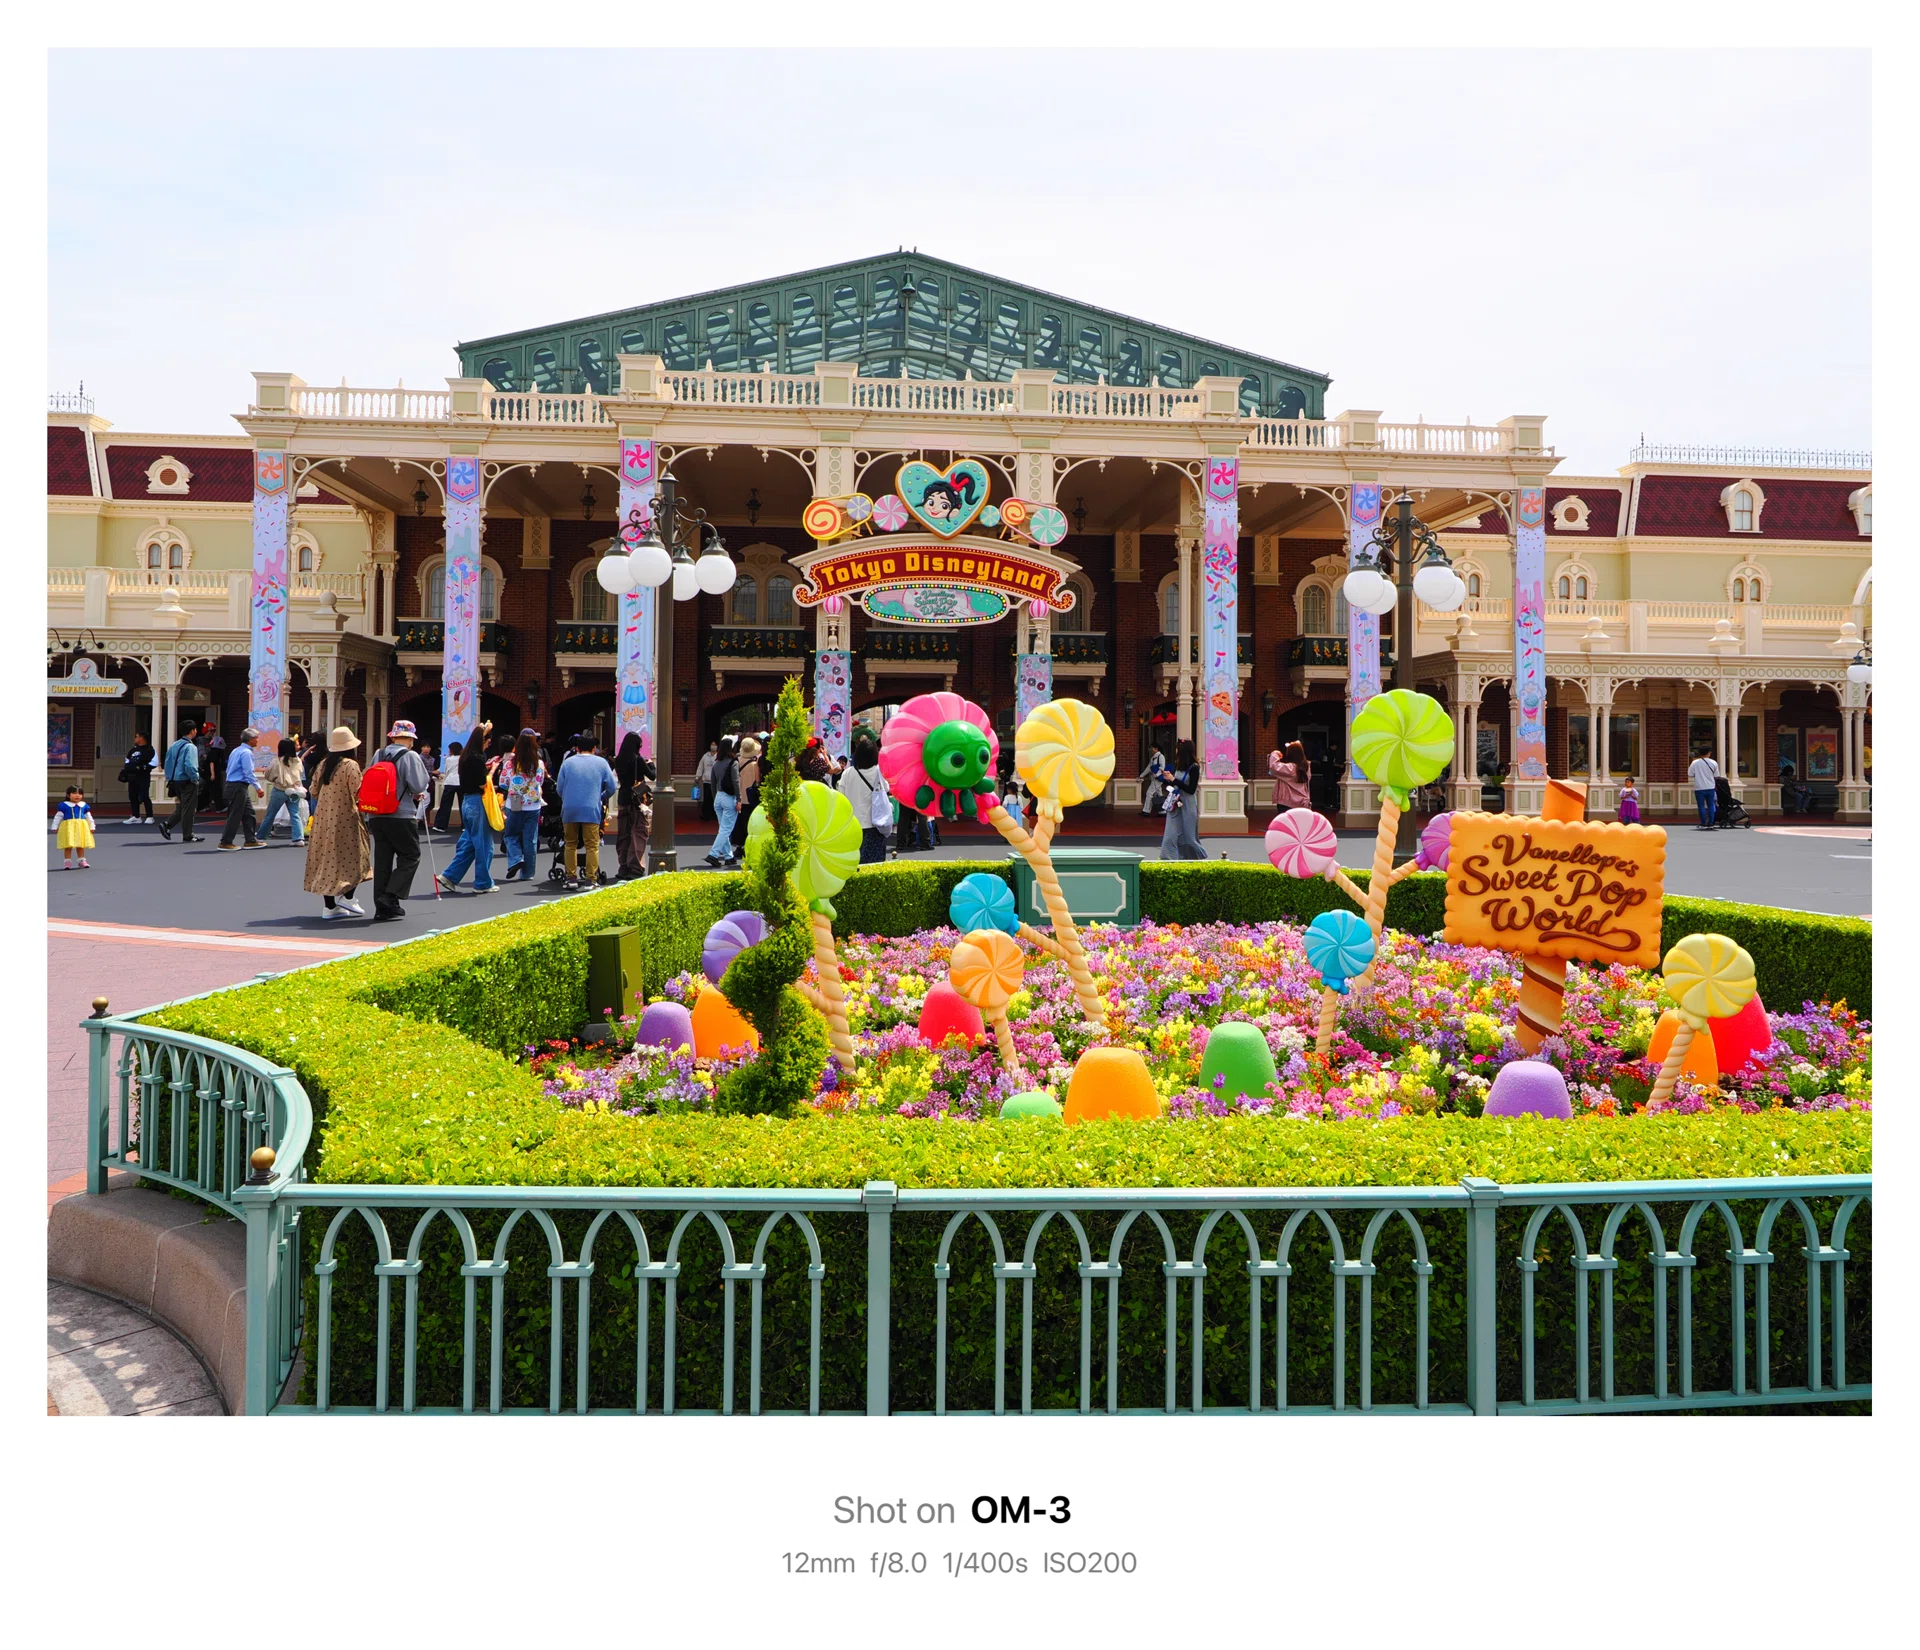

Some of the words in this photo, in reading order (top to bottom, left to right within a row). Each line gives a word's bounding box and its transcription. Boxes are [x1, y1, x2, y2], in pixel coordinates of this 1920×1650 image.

[820, 557, 896, 587] Tokyo
[905, 552, 1047, 591] Disneyland
[914, 597, 938, 608] Sweet
[938, 597, 957, 608] Pop
[920, 606, 955, 617] World
[51, 685, 118, 695] CONFECTIONERY
[252, 706, 280, 720] Candy
[623, 706, 645, 722] Jelly
[1491, 832, 1640, 878] Vanellope's
[1457, 854, 1559, 896] Sweet
[1554, 869, 1647, 917] Pop
[1480, 895, 1642, 952] World
